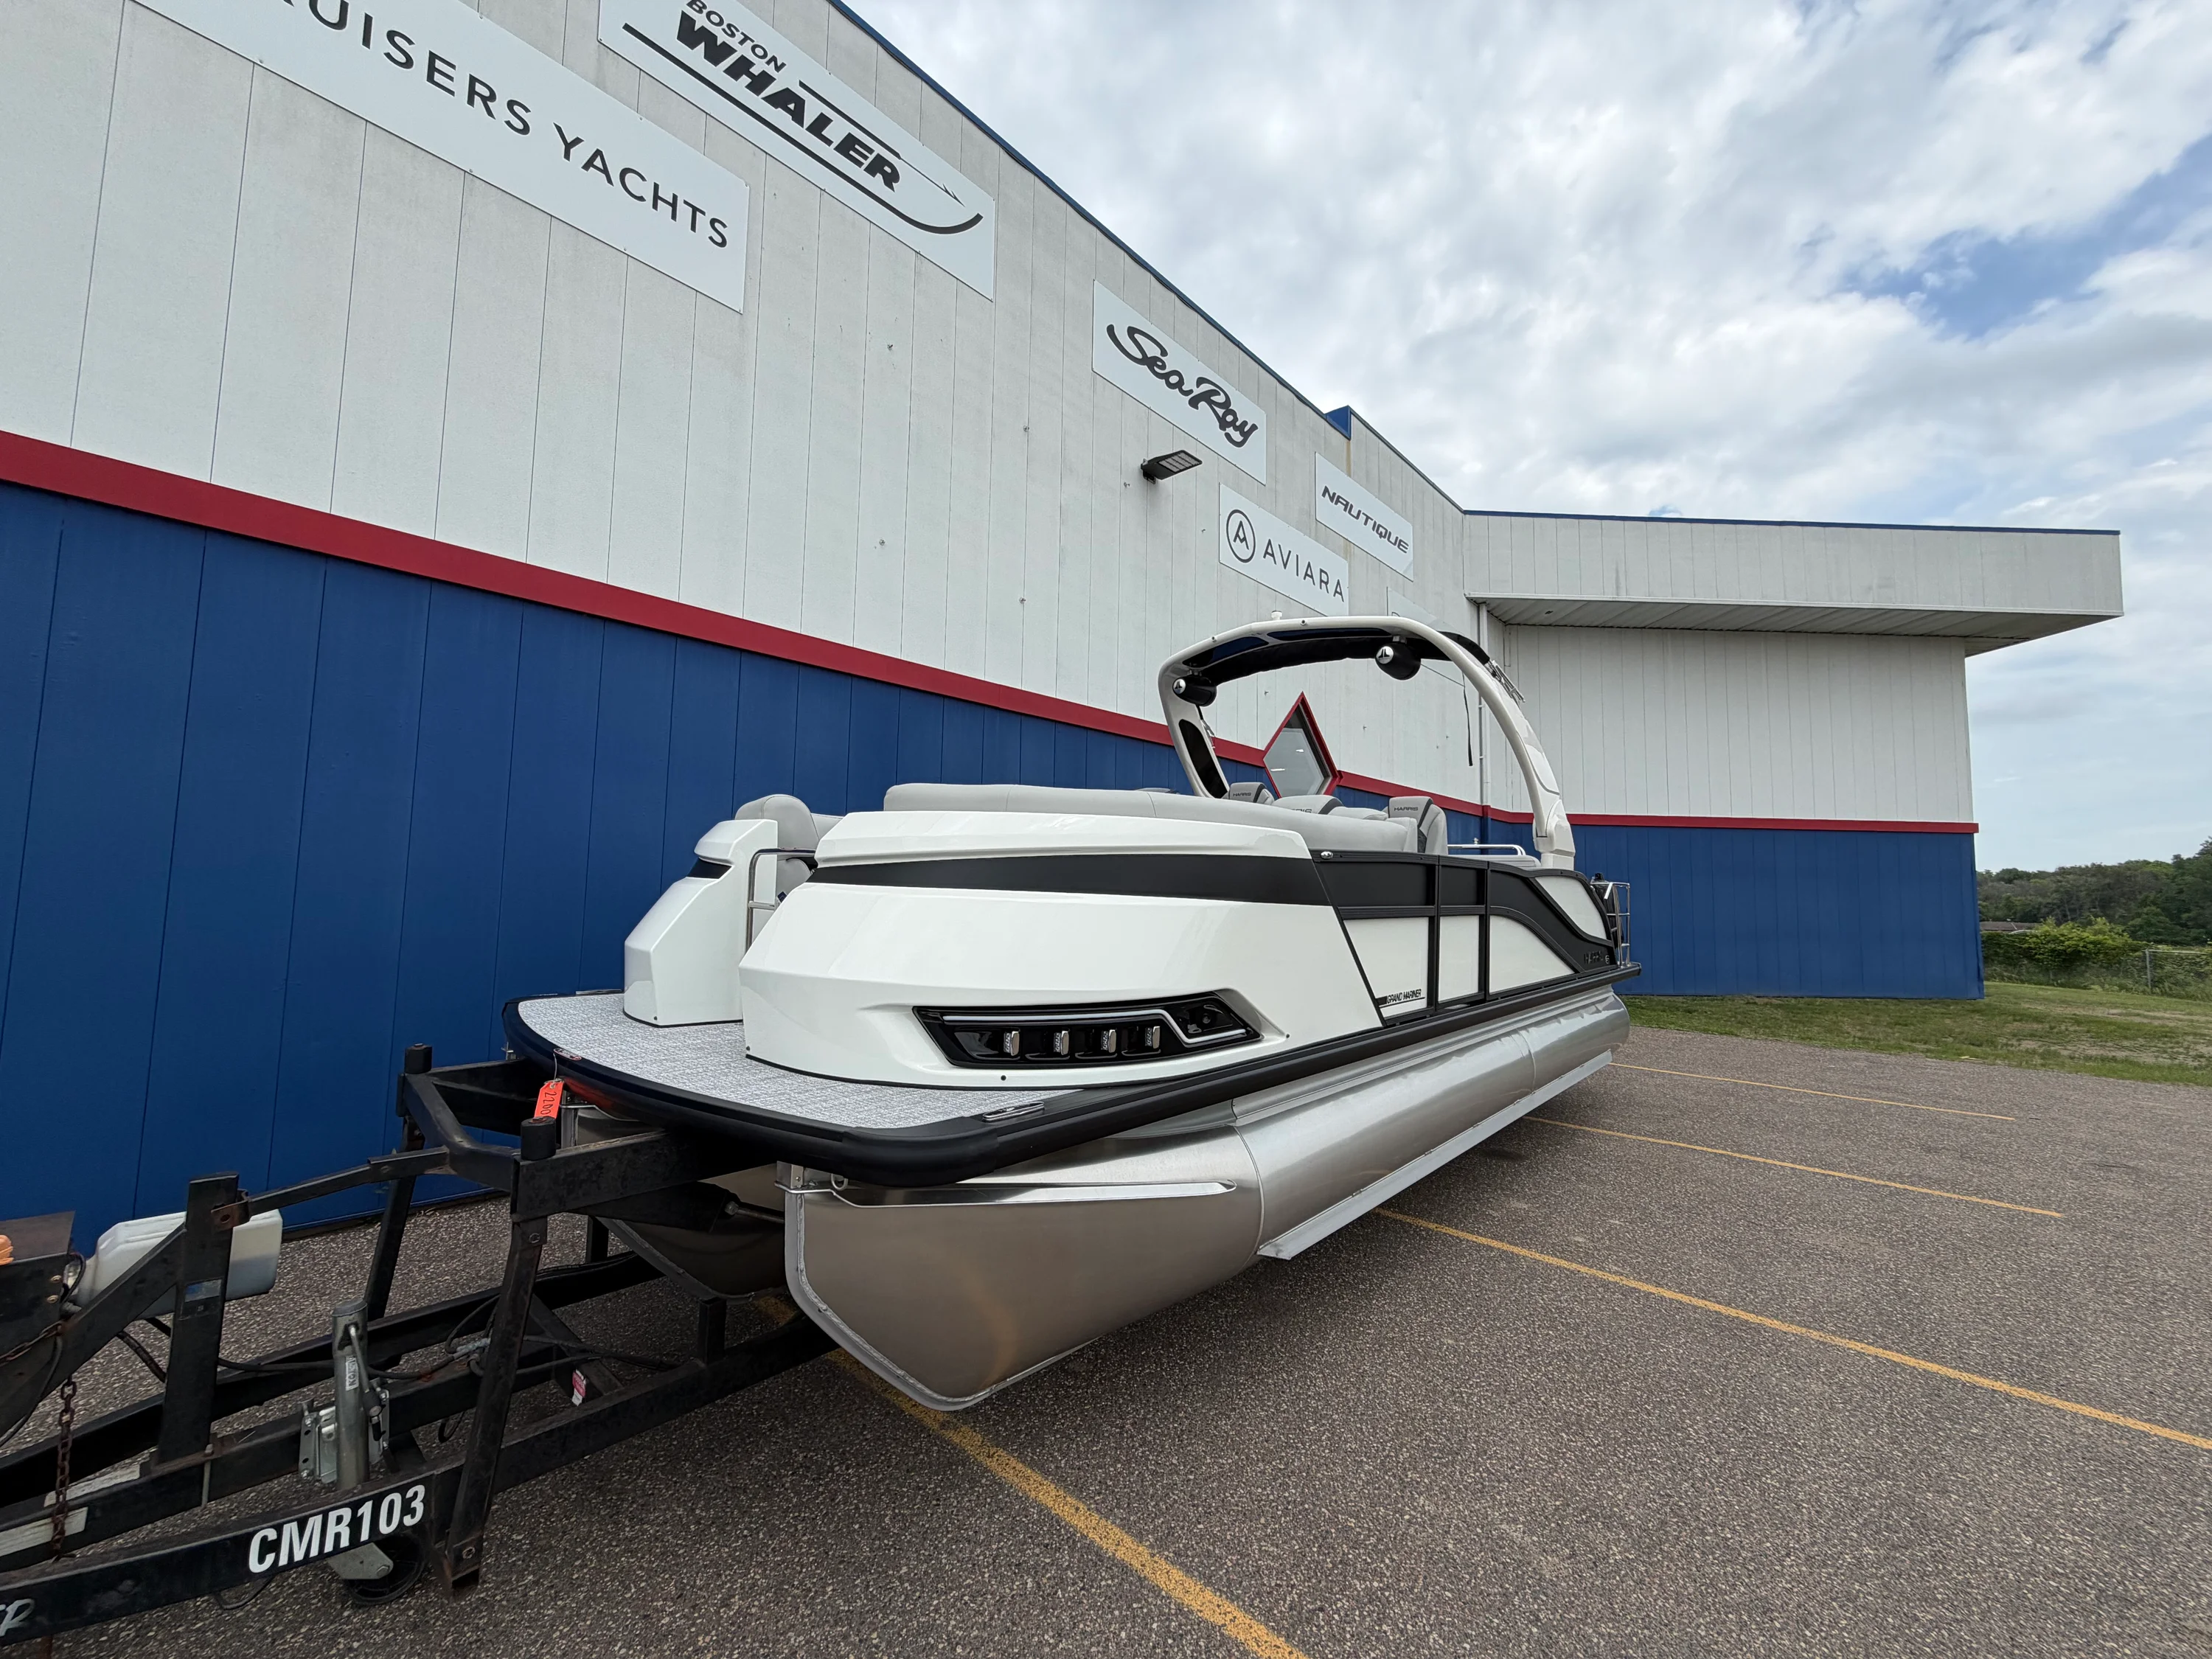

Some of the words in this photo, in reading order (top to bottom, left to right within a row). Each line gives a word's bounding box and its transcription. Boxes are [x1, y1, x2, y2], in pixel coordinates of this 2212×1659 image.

[686, 0, 787, 73] BOSTON
[283, 0, 532, 136] UISERS
[553, 122, 728, 248] YACHTS
[676, 10, 900, 192] WHALER
[1106, 324, 1194, 397] Sea
[1188, 376, 1259, 448] Ray
[1321, 485, 1409, 554] NAUTIQUE
[1263, 538, 1345, 603] AVIARA
[1388, 992, 1402, 1004] GRAND
[1403, 989, 1422, 1000] MARINER
[248, 1484, 425, 1573] CMR103
